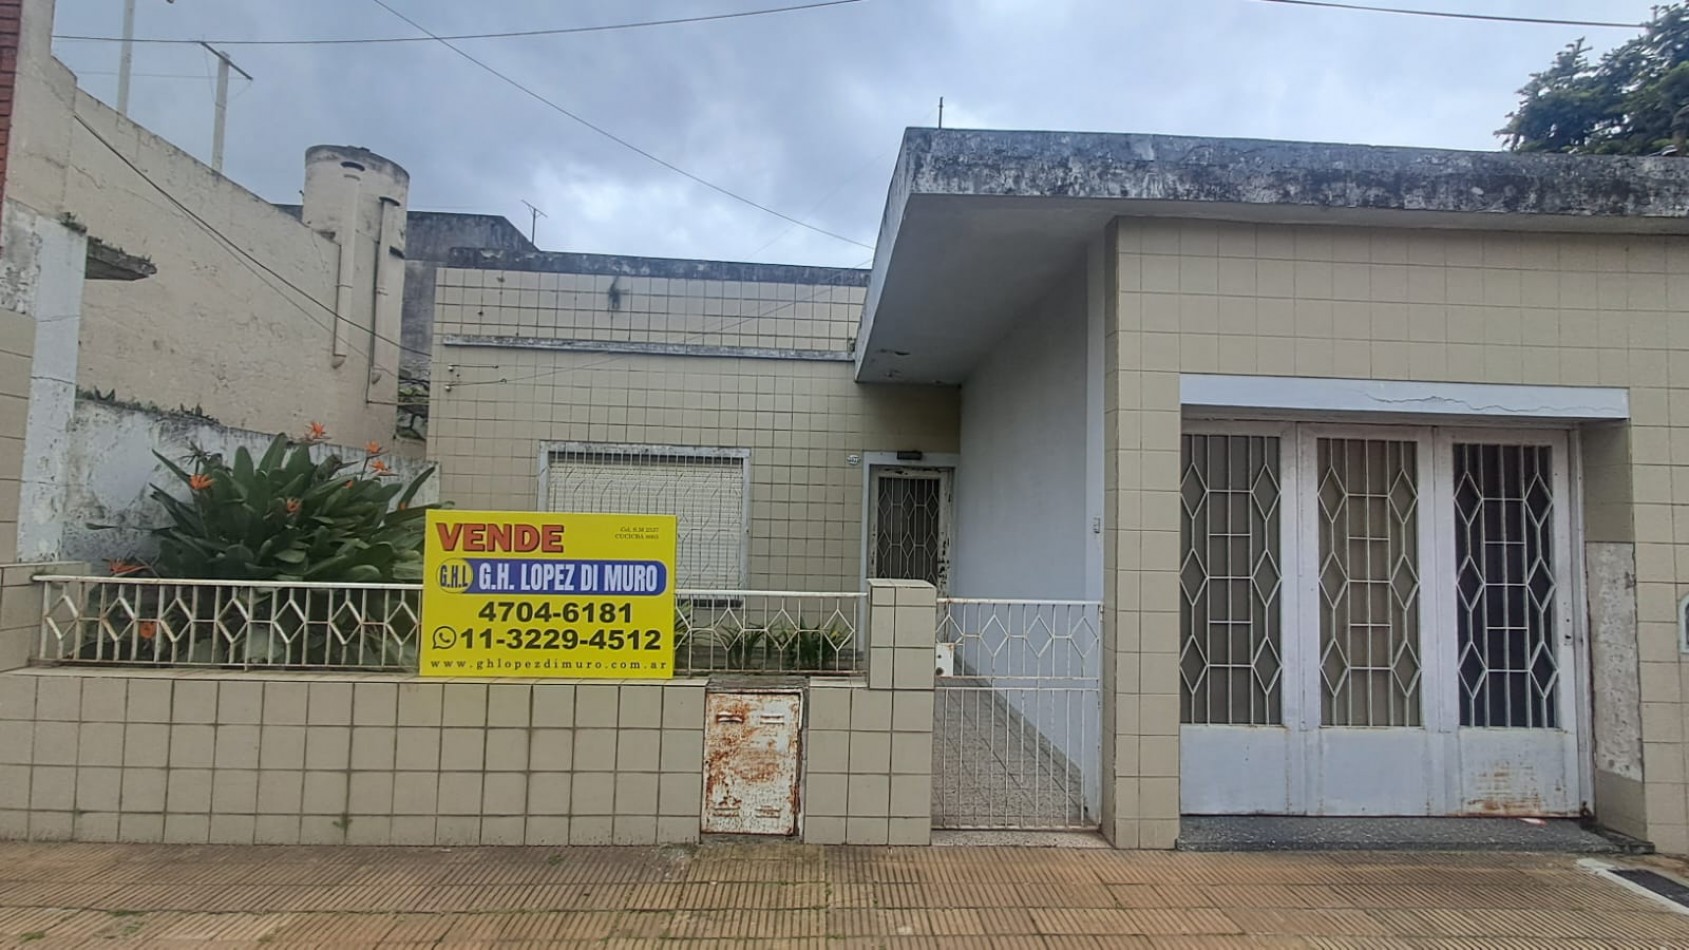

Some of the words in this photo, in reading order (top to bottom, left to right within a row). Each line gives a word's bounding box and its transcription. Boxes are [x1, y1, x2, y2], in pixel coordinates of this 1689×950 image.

[436, 522, 565, 553] VENDE
[479, 563, 515, 590] G.H.
[520, 563, 575, 591] LOPEZ
[580, 564, 598, 591] DI
[604, 565, 658, 592] MURO
[478, 602, 632, 623] 4704-6181
[460, 628, 661, 650] 11-3229-4512
[430, 659, 667, 670] www.ghlopezdimuro.com.ar
